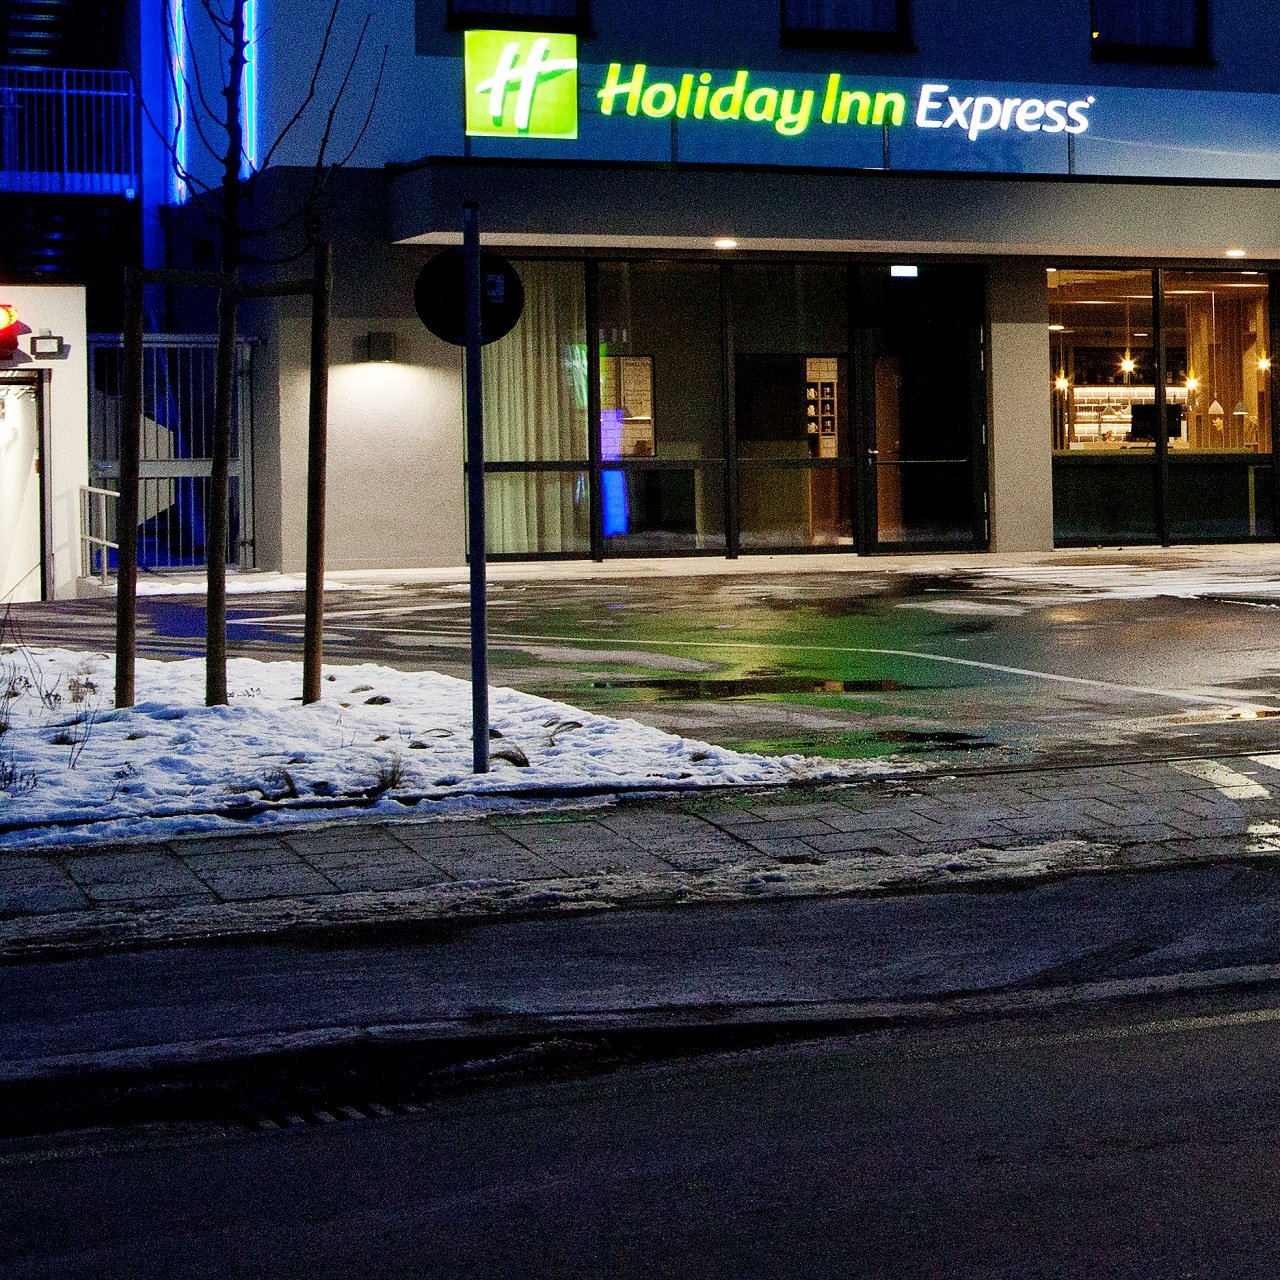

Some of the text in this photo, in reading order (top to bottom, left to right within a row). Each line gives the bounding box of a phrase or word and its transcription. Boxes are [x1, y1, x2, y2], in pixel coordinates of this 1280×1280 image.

[598, 62, 1094, 142] Holiday Inn Express
